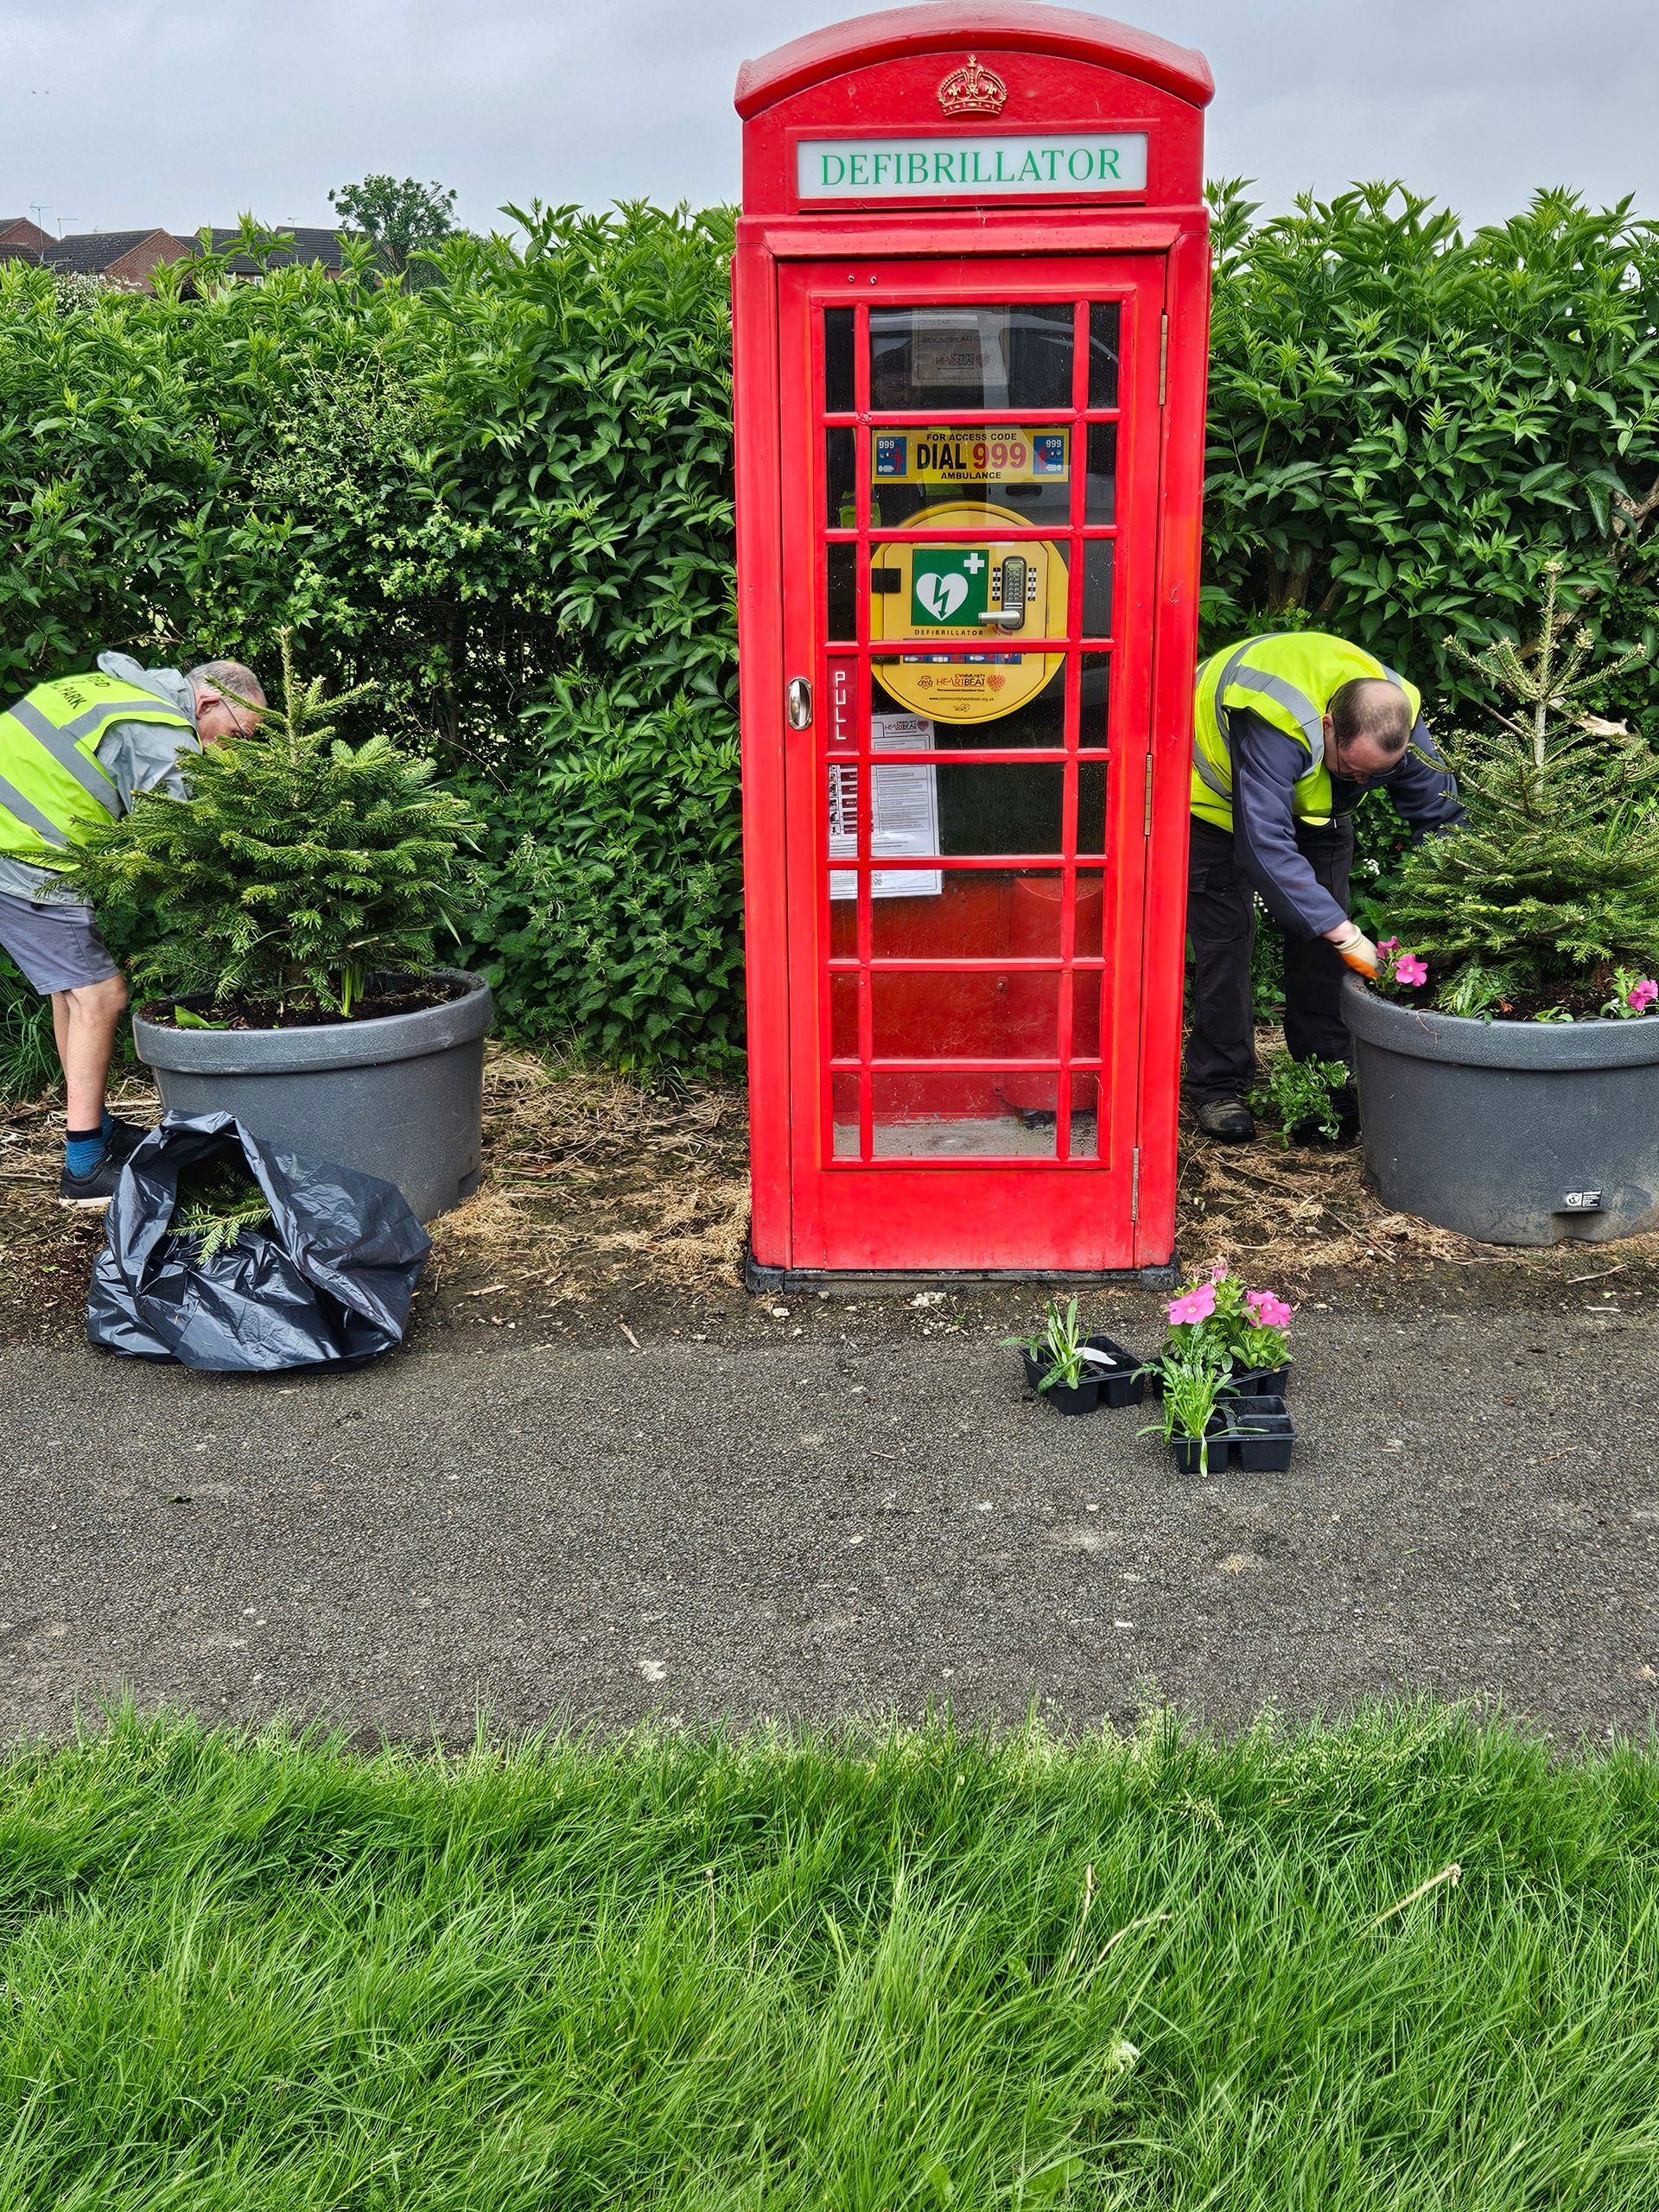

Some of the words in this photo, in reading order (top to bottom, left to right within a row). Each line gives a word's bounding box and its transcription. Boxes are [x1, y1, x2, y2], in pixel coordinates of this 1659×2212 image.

[821, 149, 1122, 185] DEFIBRILLATOR
[879, 441, 895, 449] 999
[949, 433, 987, 442] ACCESS
[1046, 439, 1062, 448] 999
[917, 443, 967, 470] DIAL
[972, 442, 1027, 469] 999
[936, 677, 985, 687] HEARTBEAT
[58, 687, 87, 709] PARK
[835, 671, 847, 741] PULL
